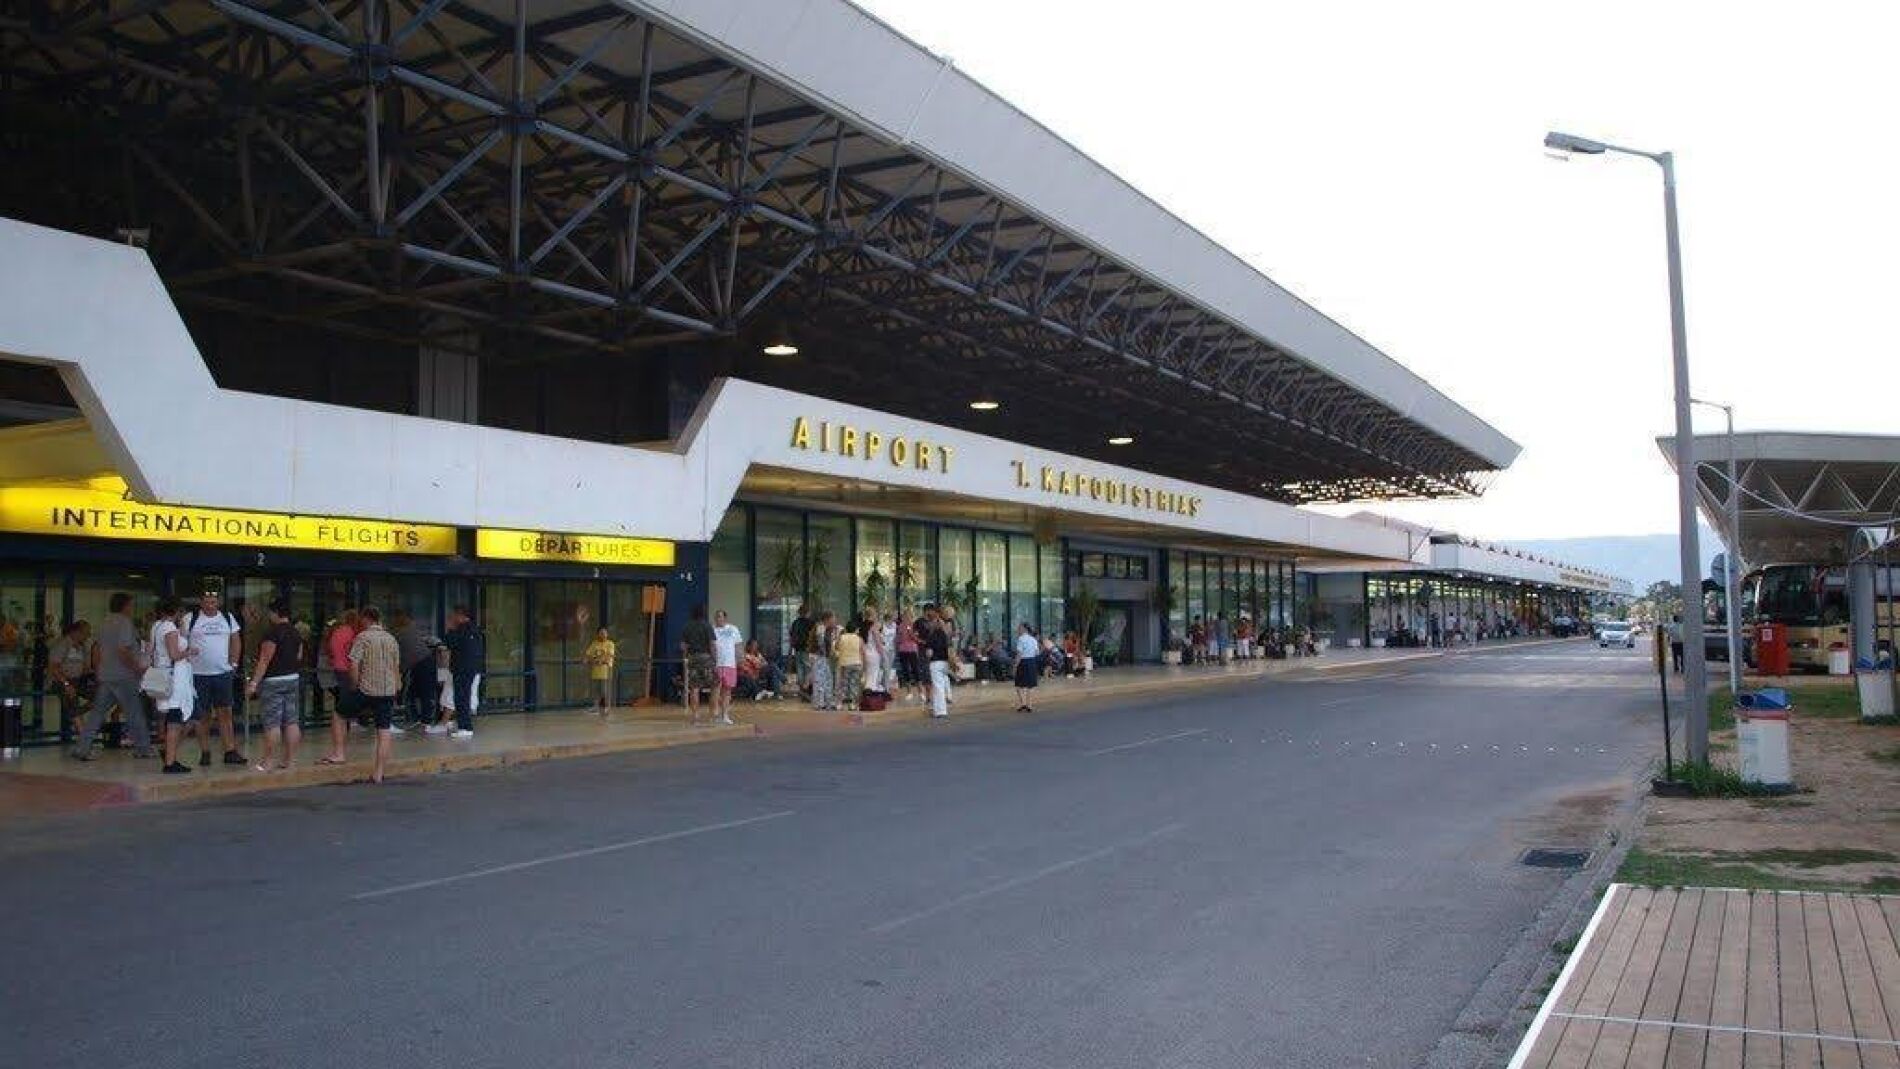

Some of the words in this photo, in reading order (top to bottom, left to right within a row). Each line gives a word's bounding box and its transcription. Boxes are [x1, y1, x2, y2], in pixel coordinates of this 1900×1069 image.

[791, 416, 953, 474] AIRPORT
[52, 507, 297, 539] INTERNATIONAL
[318, 525, 418, 547] FLIGHTS
[257, 552, 265, 567] 2
[520, 536, 641, 558] DEPARTURES
